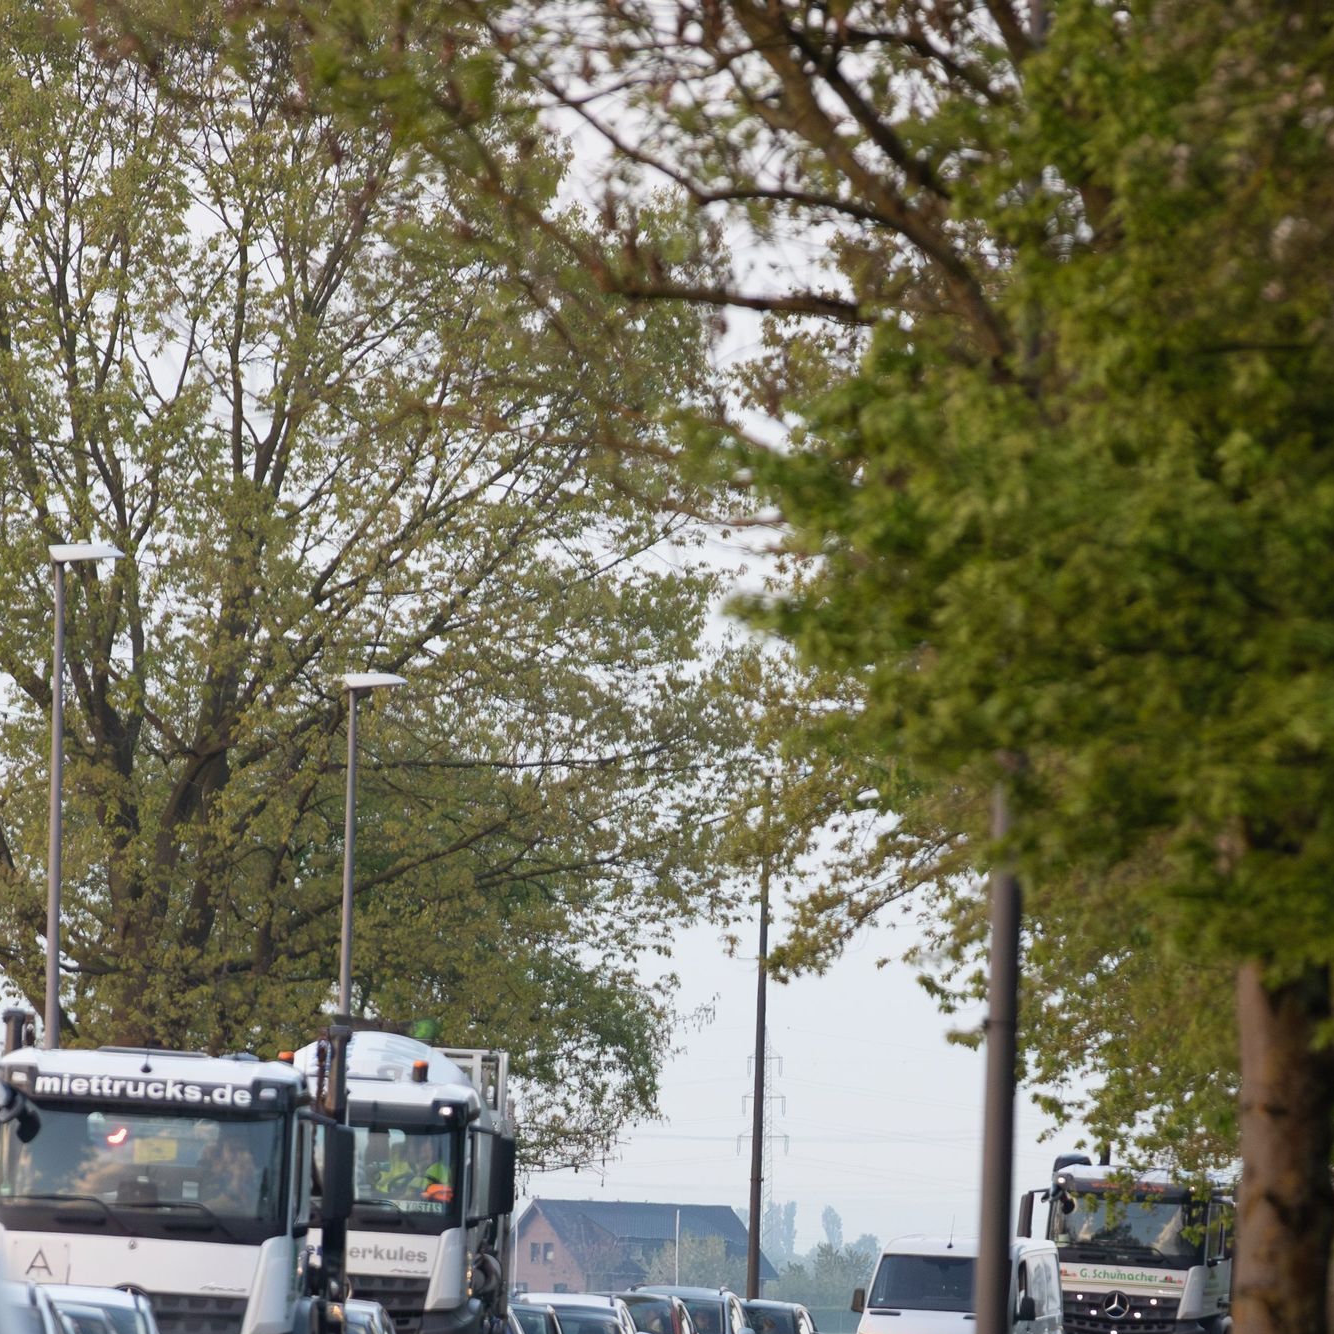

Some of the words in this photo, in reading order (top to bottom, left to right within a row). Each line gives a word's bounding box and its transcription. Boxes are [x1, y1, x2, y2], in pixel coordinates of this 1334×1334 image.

[34, 1073, 252, 1107] miettrucks.de
[25, 1246, 53, 1276] A
[348, 1243, 428, 1264] erkules
[1079, 1267, 1091, 1278] G.
[1092, 1268, 1158, 1282] Schumacher
